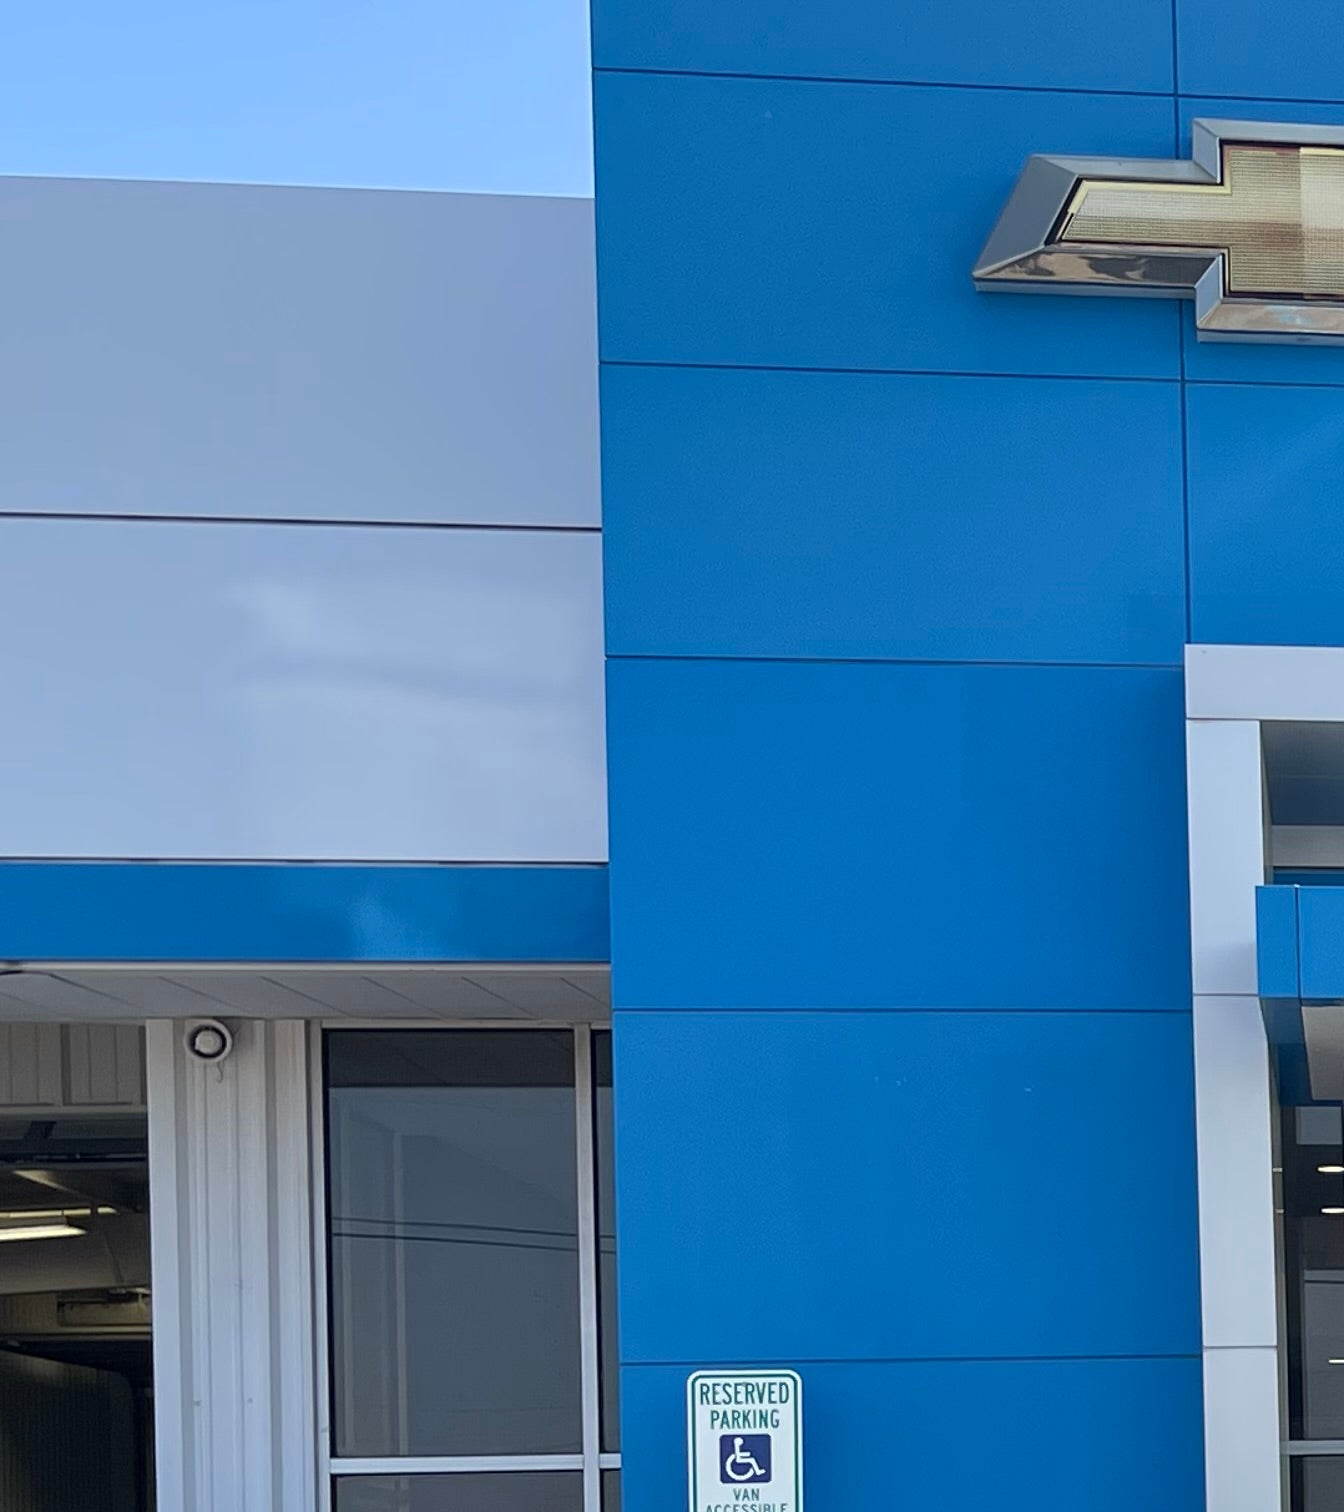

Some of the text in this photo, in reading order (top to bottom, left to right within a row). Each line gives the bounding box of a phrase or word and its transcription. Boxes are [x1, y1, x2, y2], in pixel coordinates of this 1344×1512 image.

[699, 1381, 790, 1406] RESERVED
[710, 1408, 780, 1430] PARKING
[732, 1487, 760, 1501] VAN
